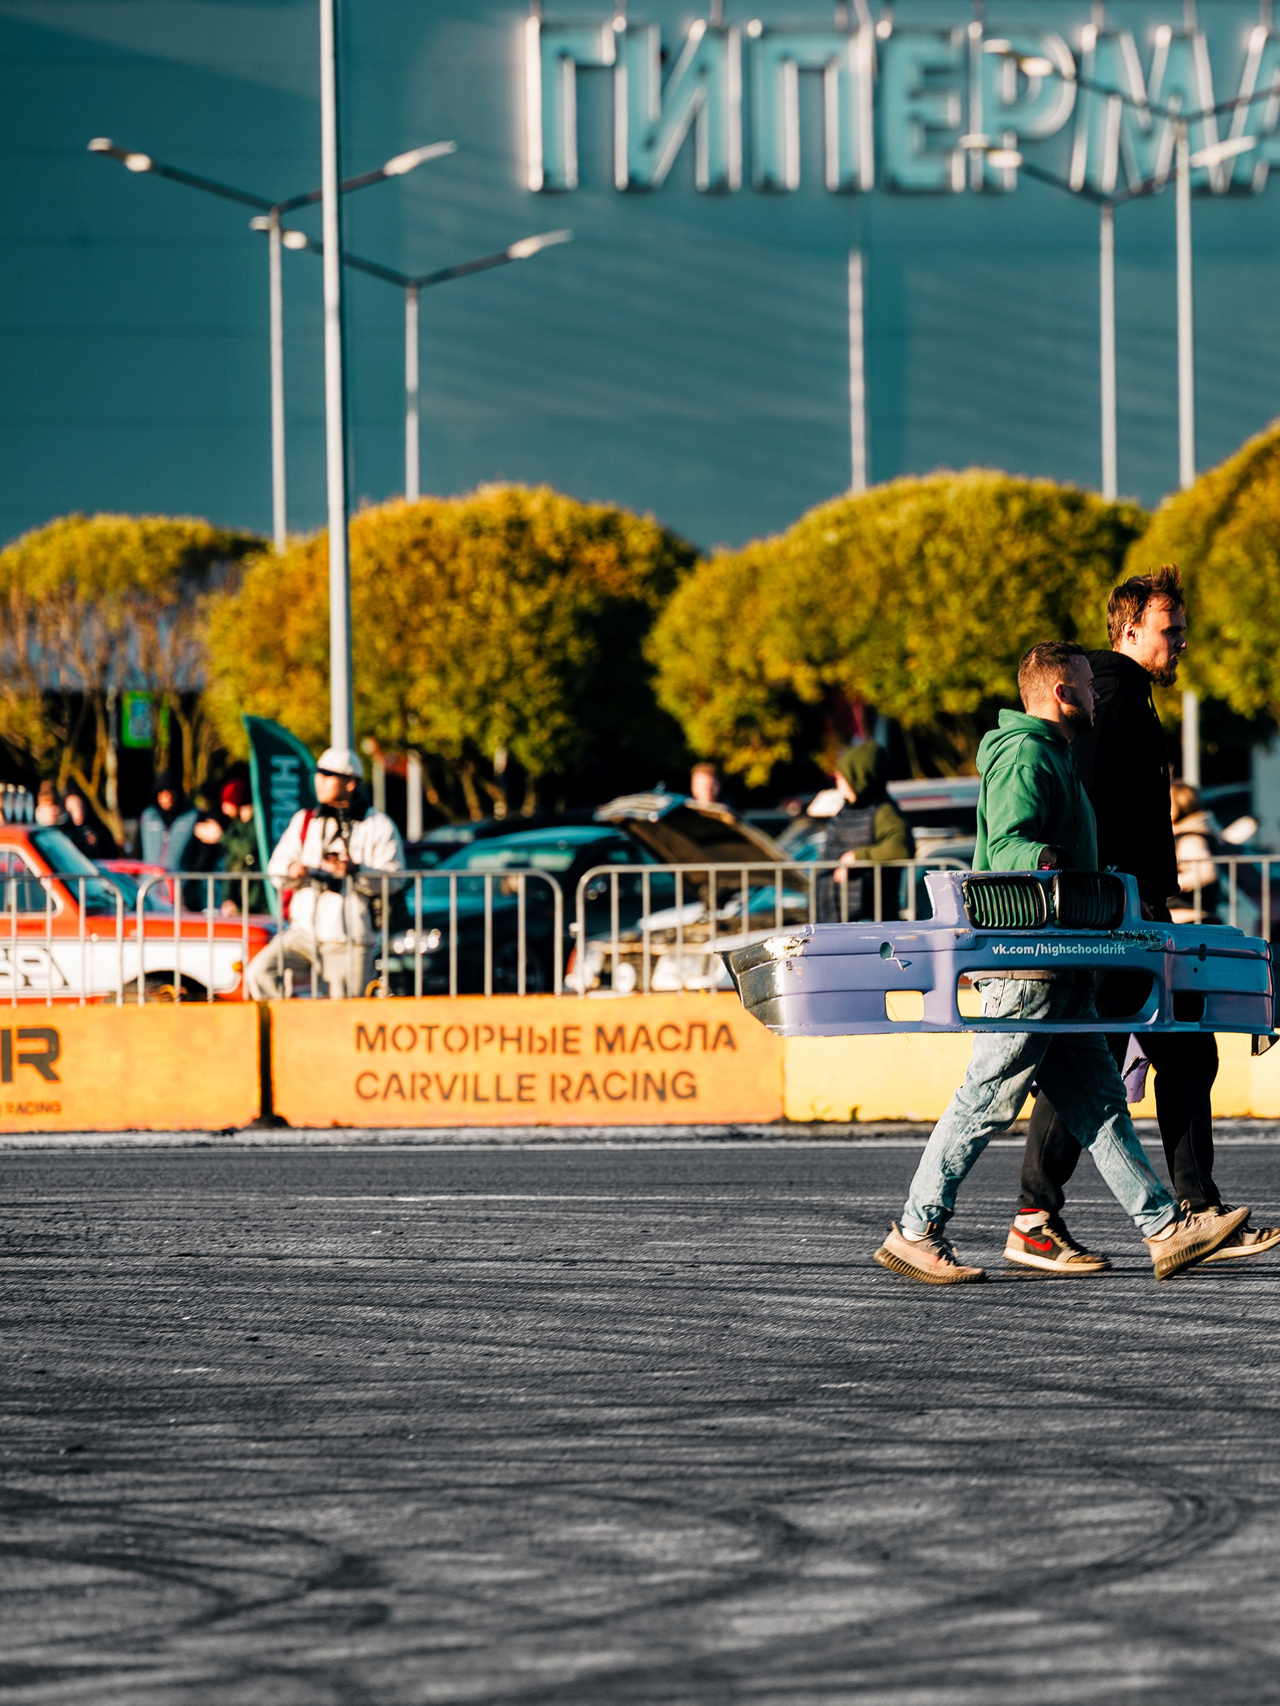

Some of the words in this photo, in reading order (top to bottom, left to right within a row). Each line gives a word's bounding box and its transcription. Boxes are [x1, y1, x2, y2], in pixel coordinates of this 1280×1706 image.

[992, 943, 1126, 957] vk.com/highschooldrift
[355, 1023, 581, 1055] МОТОРНЫЕ
[595, 1021, 738, 1054] МАСЛА
[354, 1070, 537, 1103] CARVILLE
[550, 1070, 698, 1102] RACING
